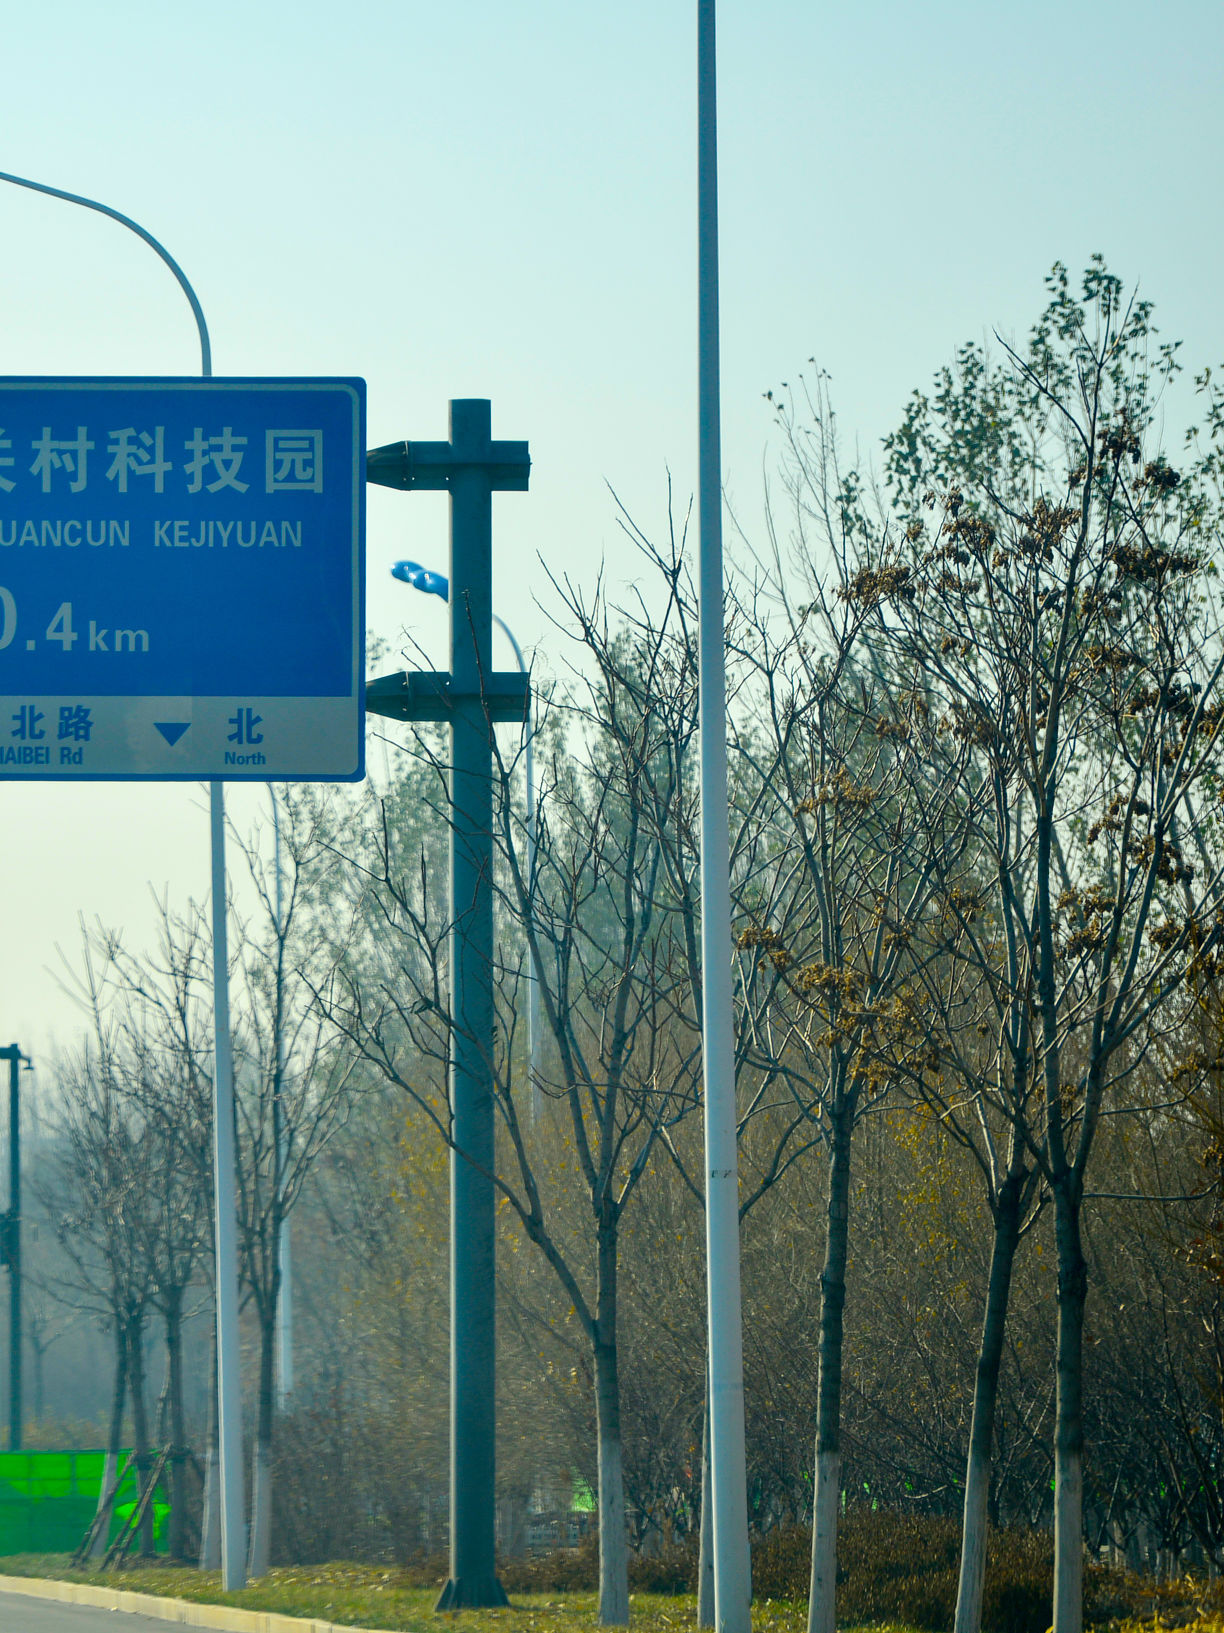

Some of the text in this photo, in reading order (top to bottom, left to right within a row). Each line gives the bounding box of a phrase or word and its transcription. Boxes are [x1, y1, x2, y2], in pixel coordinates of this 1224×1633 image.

[154, 520, 302, 548] KEJIYUAN
[88, 620, 149, 652] km
[226, 707, 264, 745] 北
[59, 746, 84, 766] Rd
[224, 751, 267, 766] North
